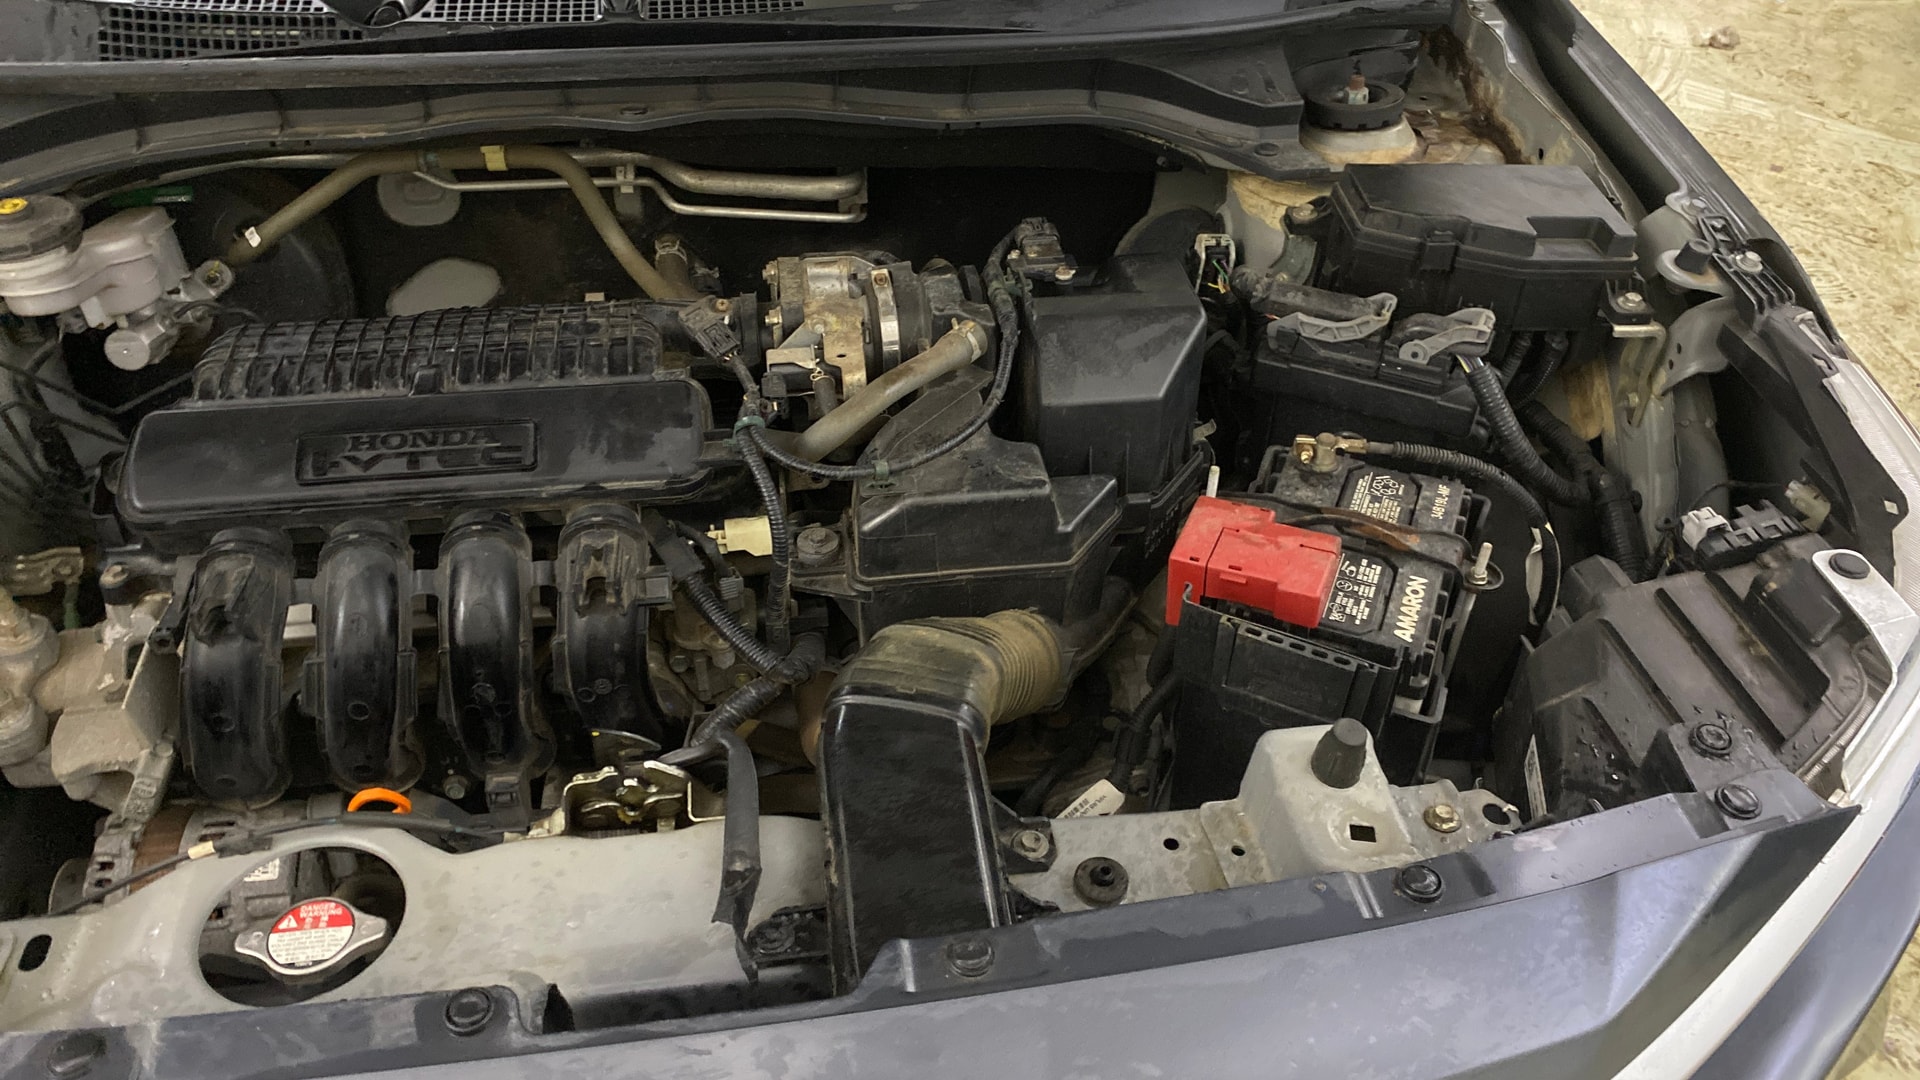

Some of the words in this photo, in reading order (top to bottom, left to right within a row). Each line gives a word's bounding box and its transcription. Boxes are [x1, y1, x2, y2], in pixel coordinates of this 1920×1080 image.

[348, 428, 501, 452] HONDA
[1393, 575, 1429, 643] AMARON
[299, 908, 343, 919] WARNING
[300, 902, 337, 912] DANGER
